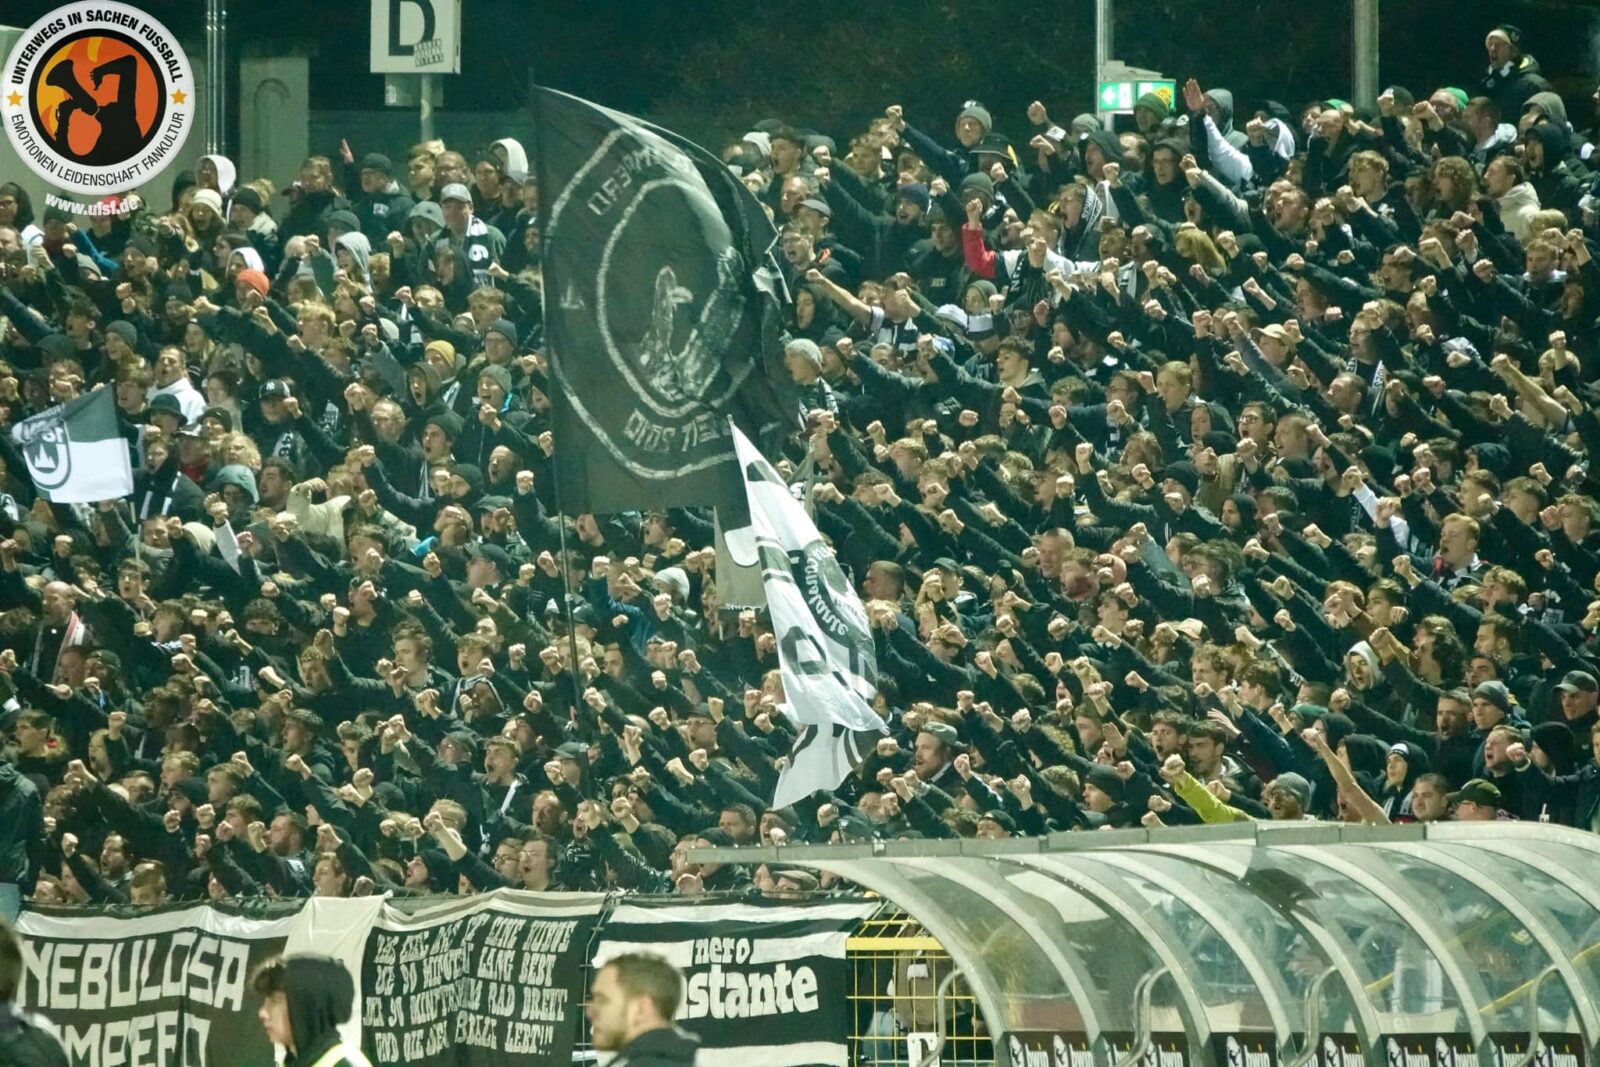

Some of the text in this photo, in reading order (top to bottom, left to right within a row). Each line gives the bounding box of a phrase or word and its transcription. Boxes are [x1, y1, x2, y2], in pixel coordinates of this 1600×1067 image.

[388, 0, 435, 56] D
[477, 946, 516, 982] LANG
[695, 936, 750, 964] nero
[17, 931, 250, 1011] NEBULOSA
[488, 981, 515, 1017] RAD
[521, 986, 568, 1021] DREHT
